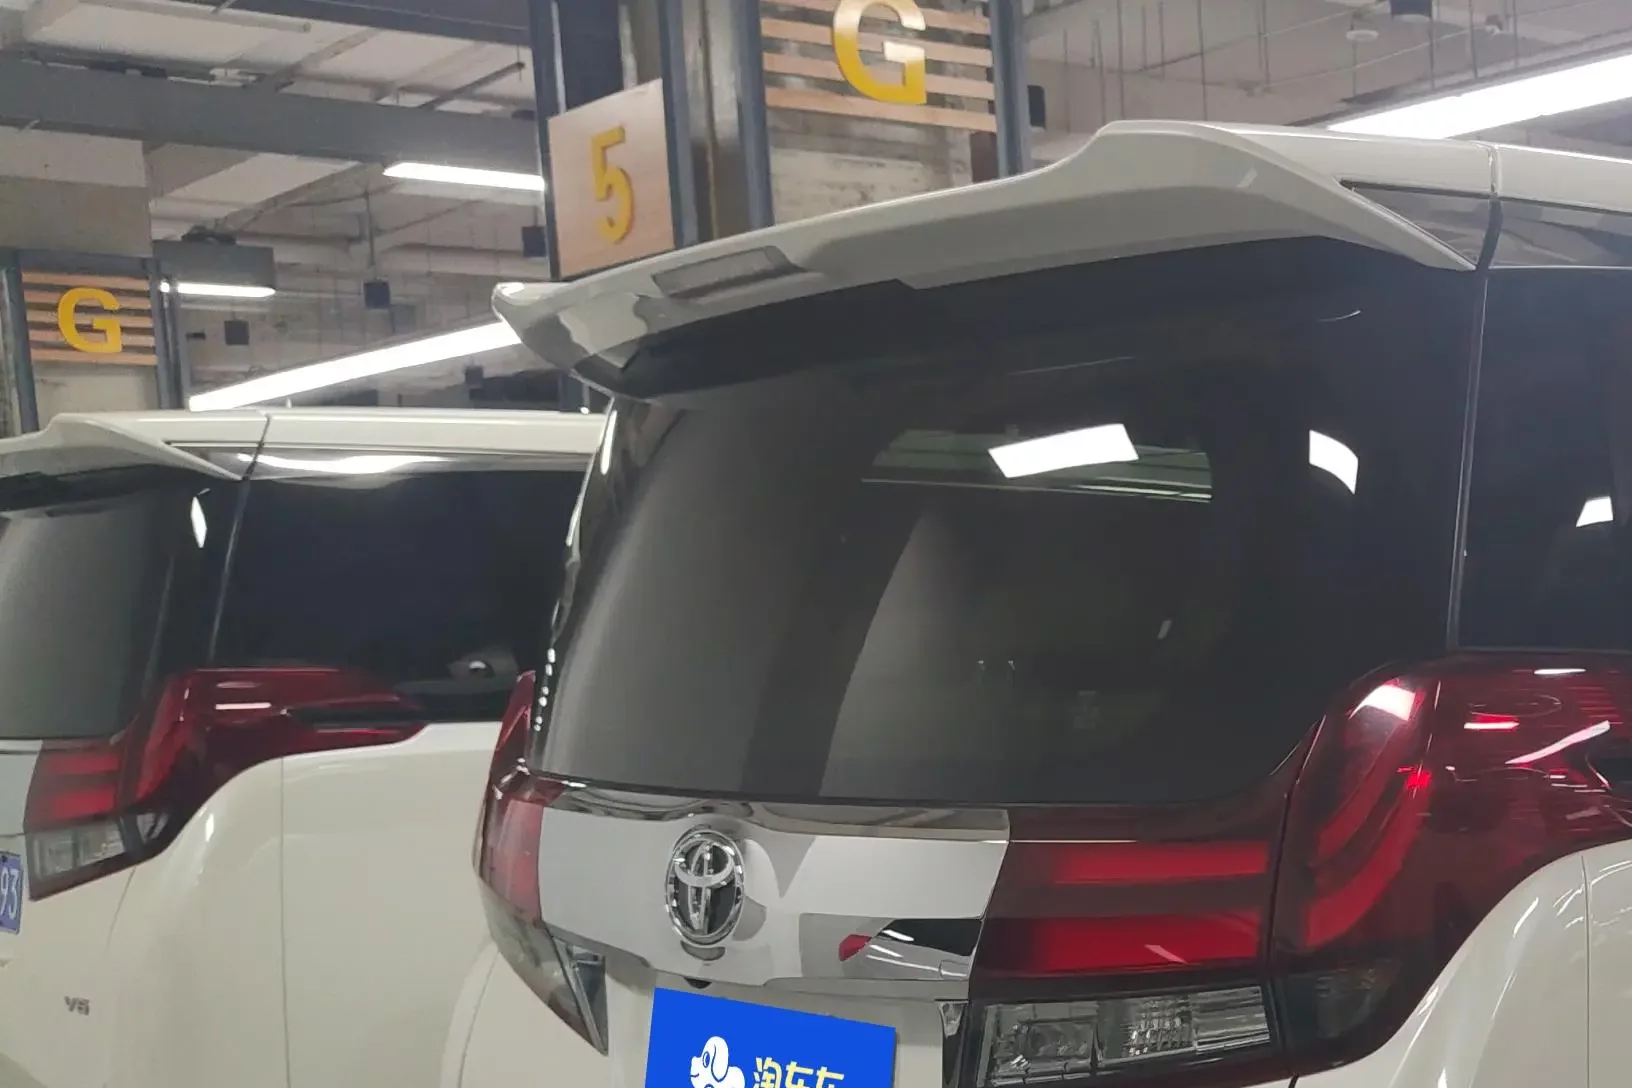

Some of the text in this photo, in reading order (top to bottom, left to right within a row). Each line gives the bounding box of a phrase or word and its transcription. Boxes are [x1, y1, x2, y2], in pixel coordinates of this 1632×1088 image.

[832, 0, 926, 105] G
[591, 126, 634, 244] 5
[57, 287, 122, 353] G
